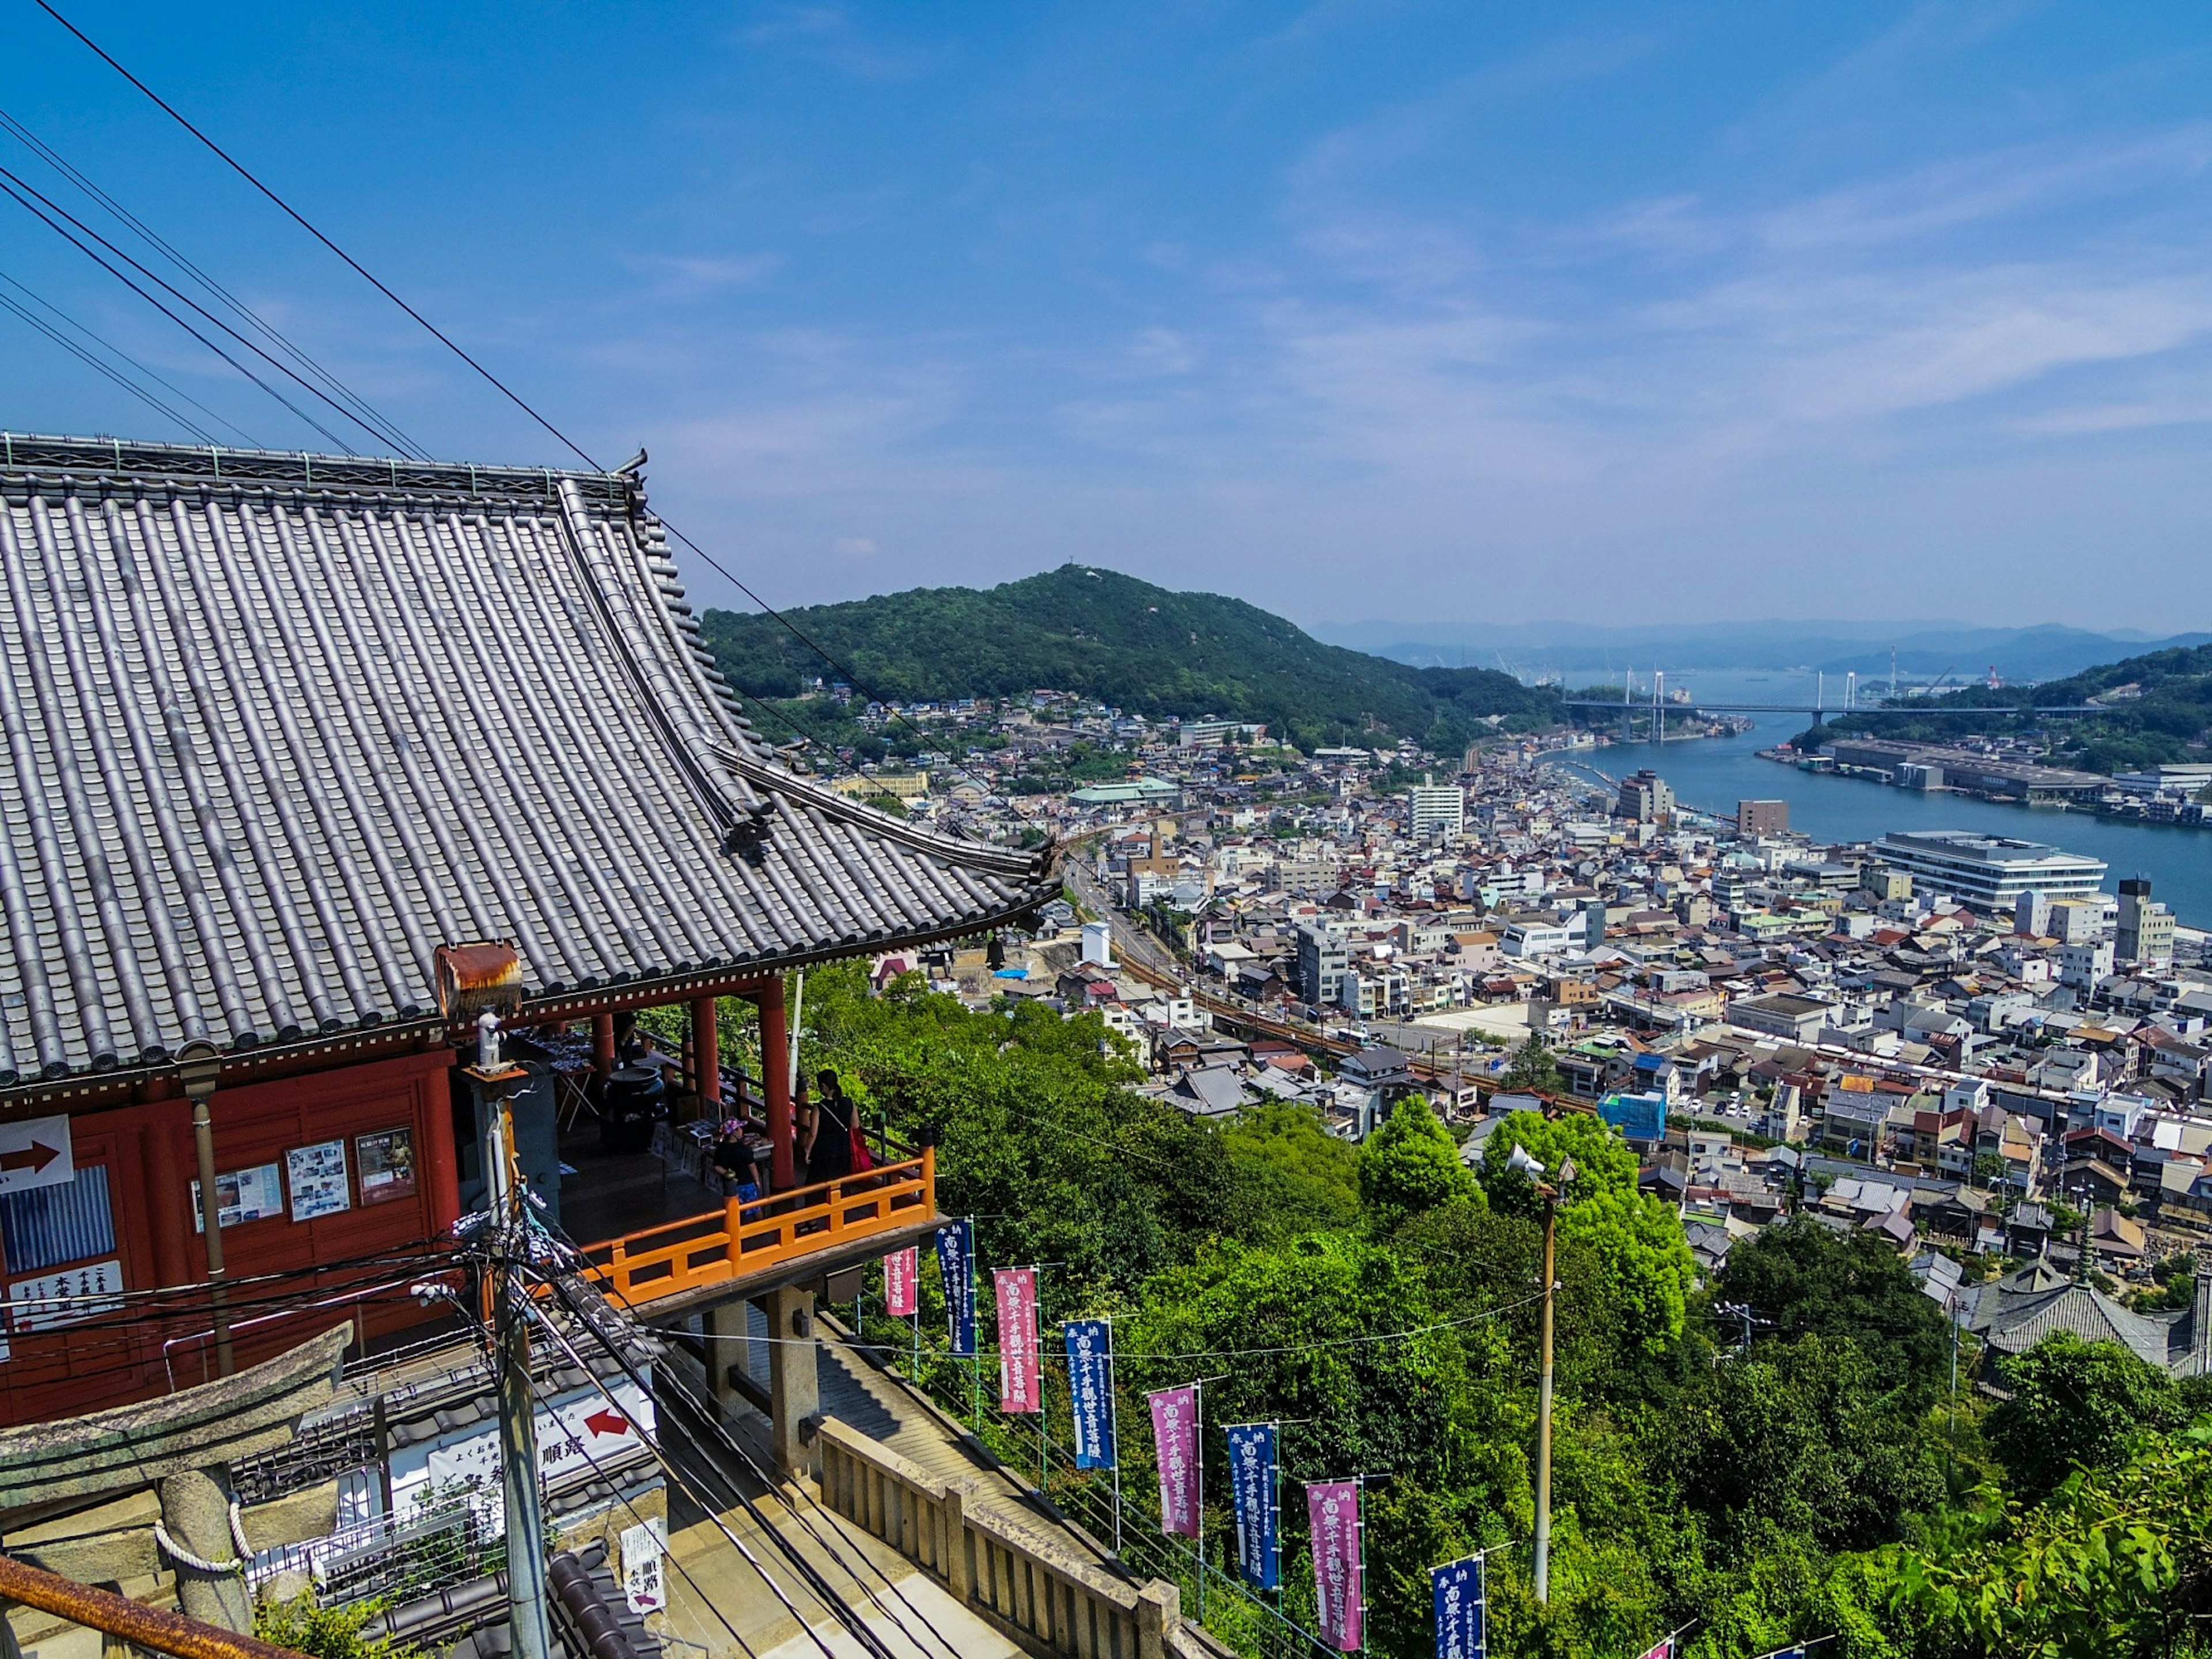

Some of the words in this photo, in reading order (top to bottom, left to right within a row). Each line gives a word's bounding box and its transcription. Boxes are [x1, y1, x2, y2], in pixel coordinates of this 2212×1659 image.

[891, 1250, 904, 1308] 世音菩薩
[642, 1559, 658, 1593] 順路
